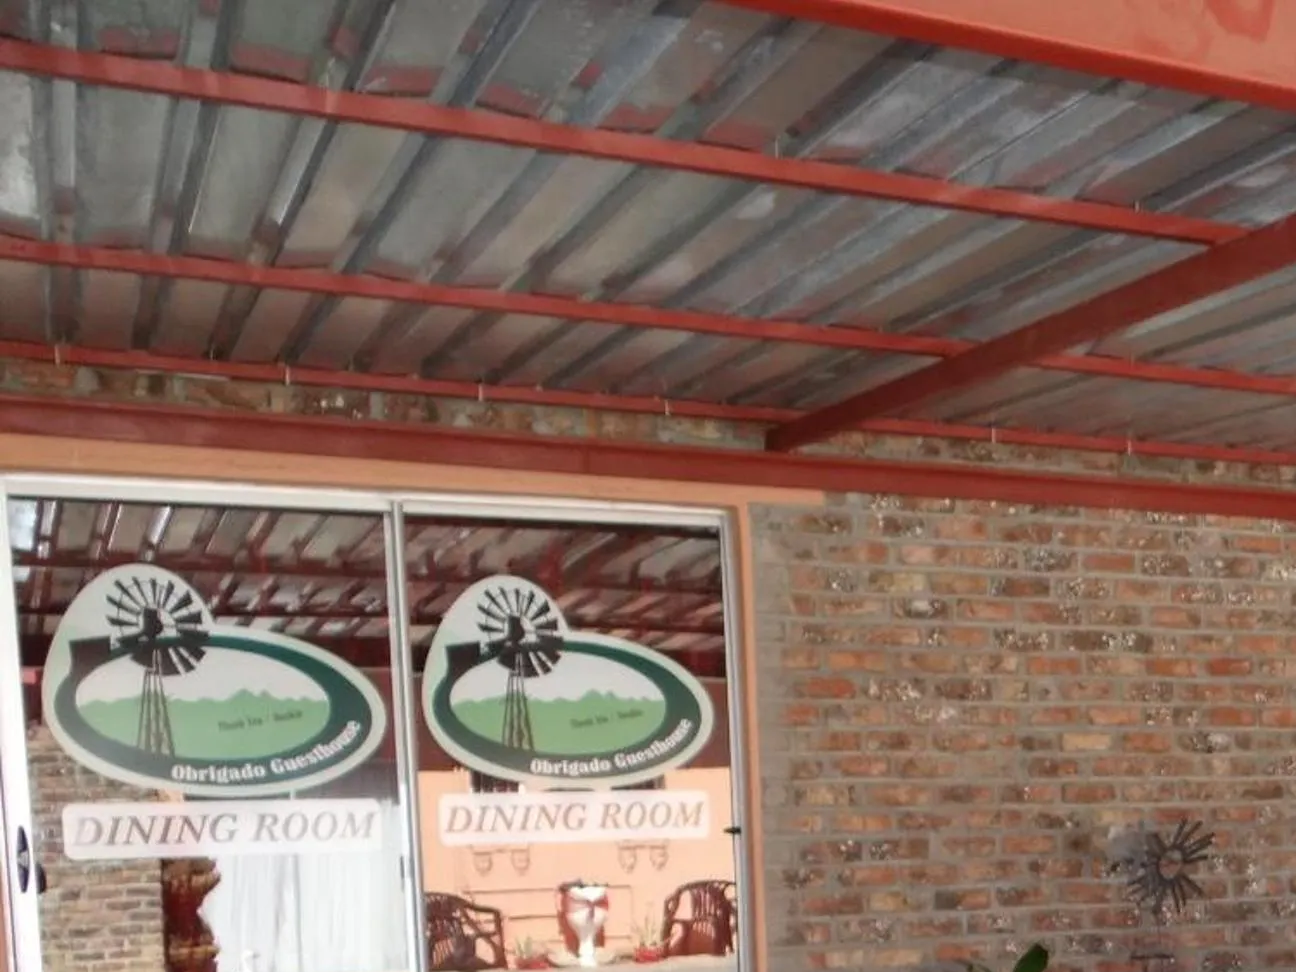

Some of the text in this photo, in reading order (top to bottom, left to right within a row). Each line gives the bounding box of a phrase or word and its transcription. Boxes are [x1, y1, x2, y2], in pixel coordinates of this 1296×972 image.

[171, 762, 266, 783] Obrigado
[270, 719, 361, 774] Guesthouse
[530, 757, 611, 777] Obrigado
[614, 718, 692, 768] Guesthouse
[73, 811, 376, 847] DINING ROOM
[445, 800, 704, 834] DINING ROOM
